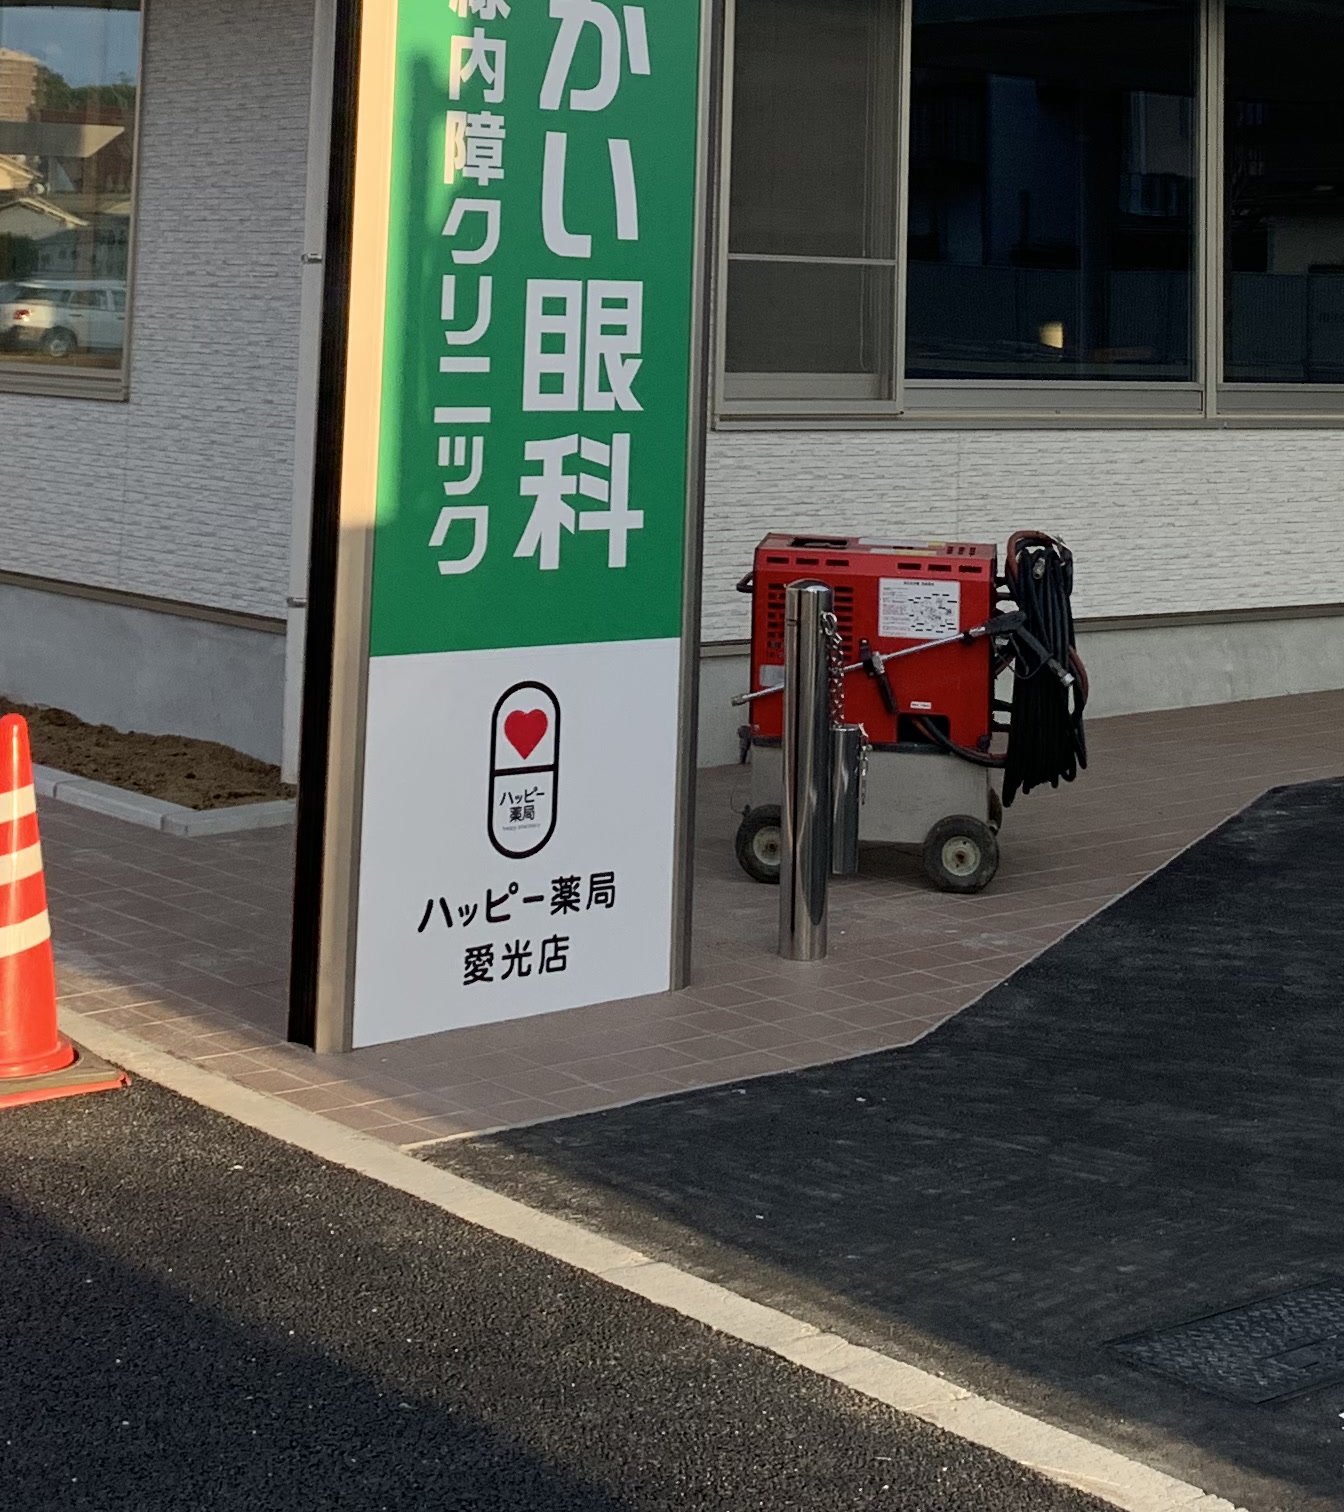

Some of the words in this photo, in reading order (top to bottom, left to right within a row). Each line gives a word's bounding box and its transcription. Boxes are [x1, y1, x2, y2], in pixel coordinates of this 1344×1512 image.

[499, 786, 545, 806] ハッピー
[509, 804, 535, 823] 薬局
[417, 871, 616, 933] ハッピー薬局
[463, 934, 570, 985] 愛光店
